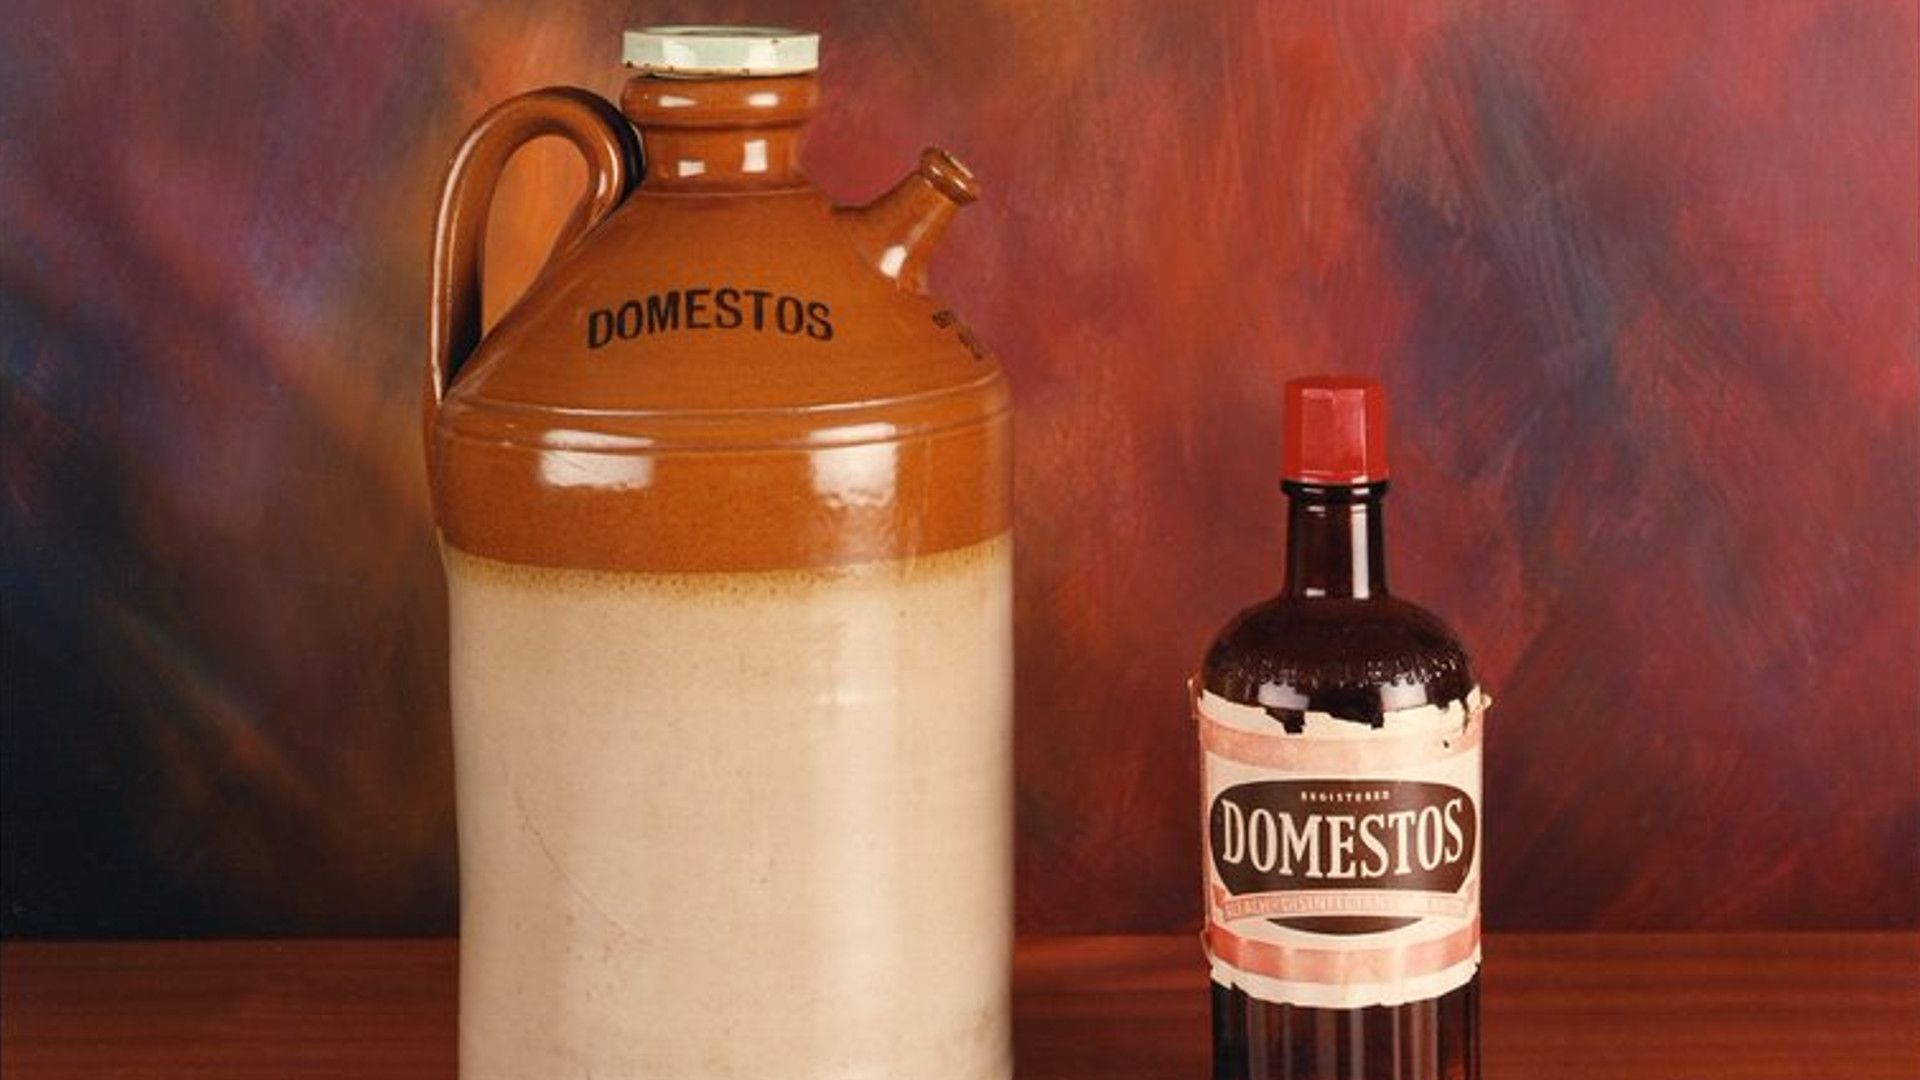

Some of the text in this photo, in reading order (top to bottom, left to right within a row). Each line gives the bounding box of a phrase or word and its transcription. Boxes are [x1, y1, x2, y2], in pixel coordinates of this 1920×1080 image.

[587, 288, 834, 350] DOMESTOS
[1301, 790, 1390, 802] REGISTERED
[1222, 798, 1464, 879] DOMESTOS
